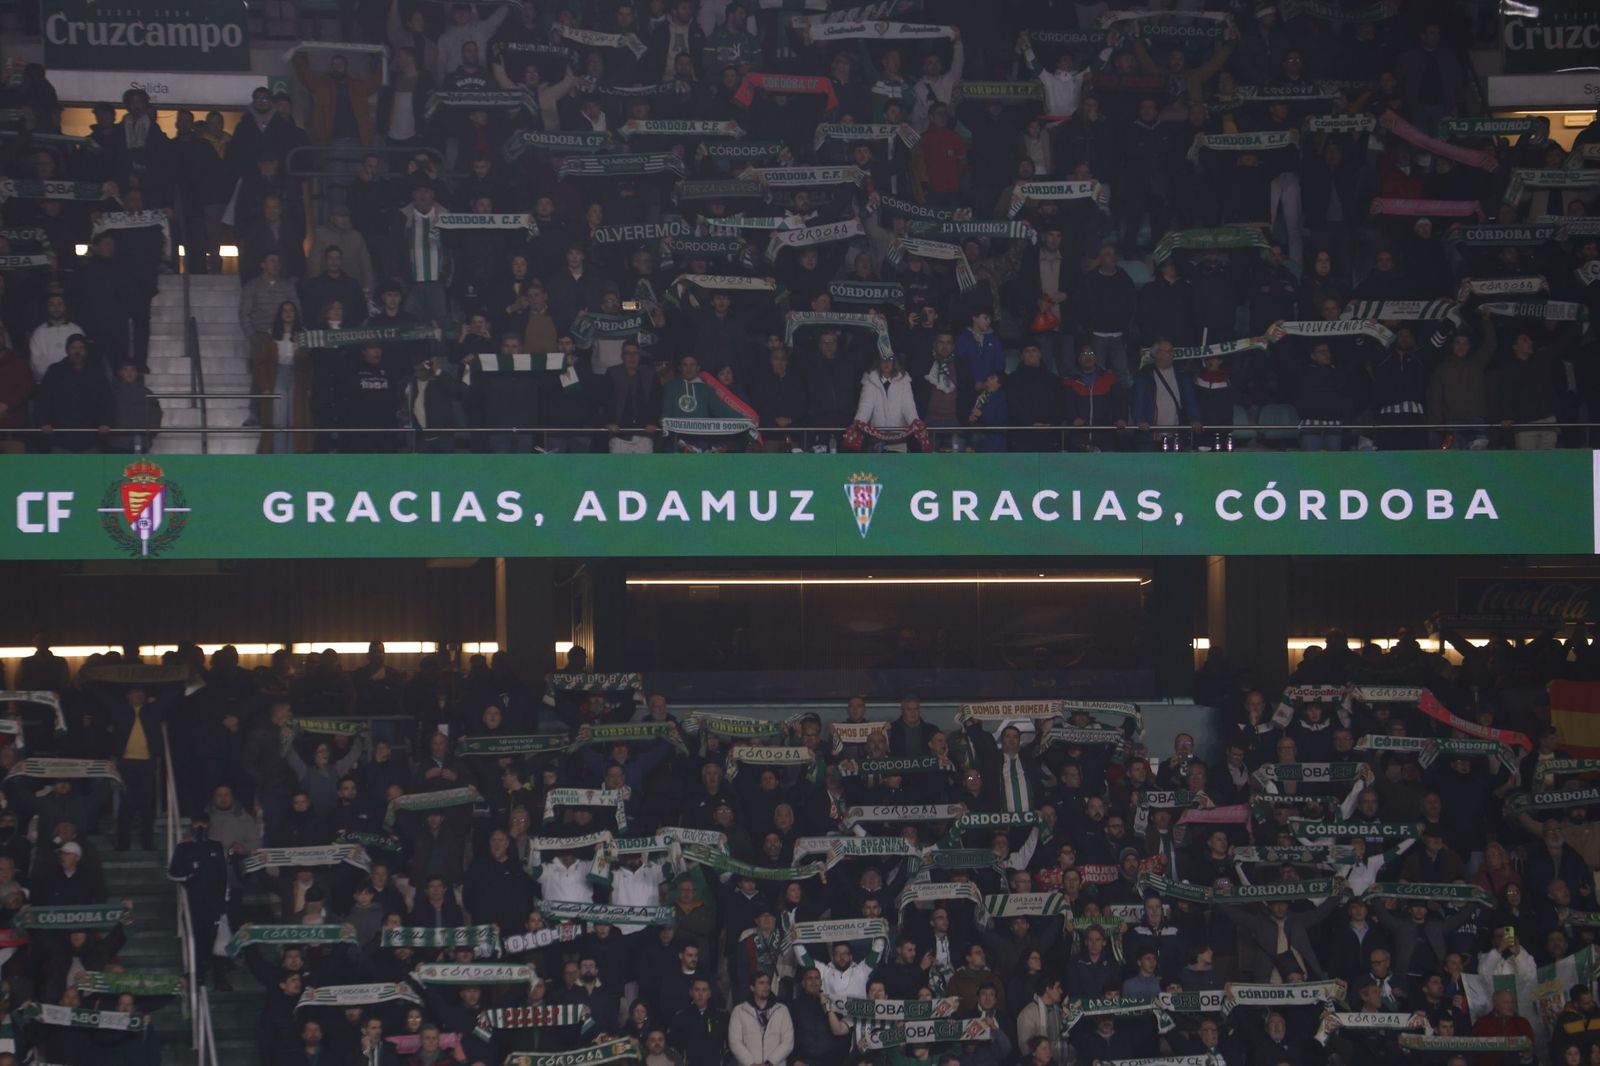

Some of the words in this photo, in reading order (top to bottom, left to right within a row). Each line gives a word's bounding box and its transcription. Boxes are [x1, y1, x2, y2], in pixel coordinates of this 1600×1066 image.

[45, 10, 243, 53] Cruzcampo
[1207, 27, 1222, 37] CF
[586, 136, 603, 146] CF
[937, 209, 952, 221] CF
[594, 221, 691, 243] OLVEREMOS
[1536, 229, 1553, 240] CF
[1174, 344, 1213, 359] DOBA
[17, 492, 73, 532] CF
[263, 490, 543, 526] GRACIAS,
[573, 490, 814, 522] ADAMUZ
[910, 490, 1183, 525] GRACIAS,
[1216, 481, 1498, 521] CÓRDOBA
[971, 704, 1000, 716] SOMOS
[1002, 704, 1013, 715] DE
[1015, 704, 1049, 715] PRIMERA
[922, 758, 936, 768] CF
[664, 836, 673, 846] C
[1309, 883, 1329, 895] CF
